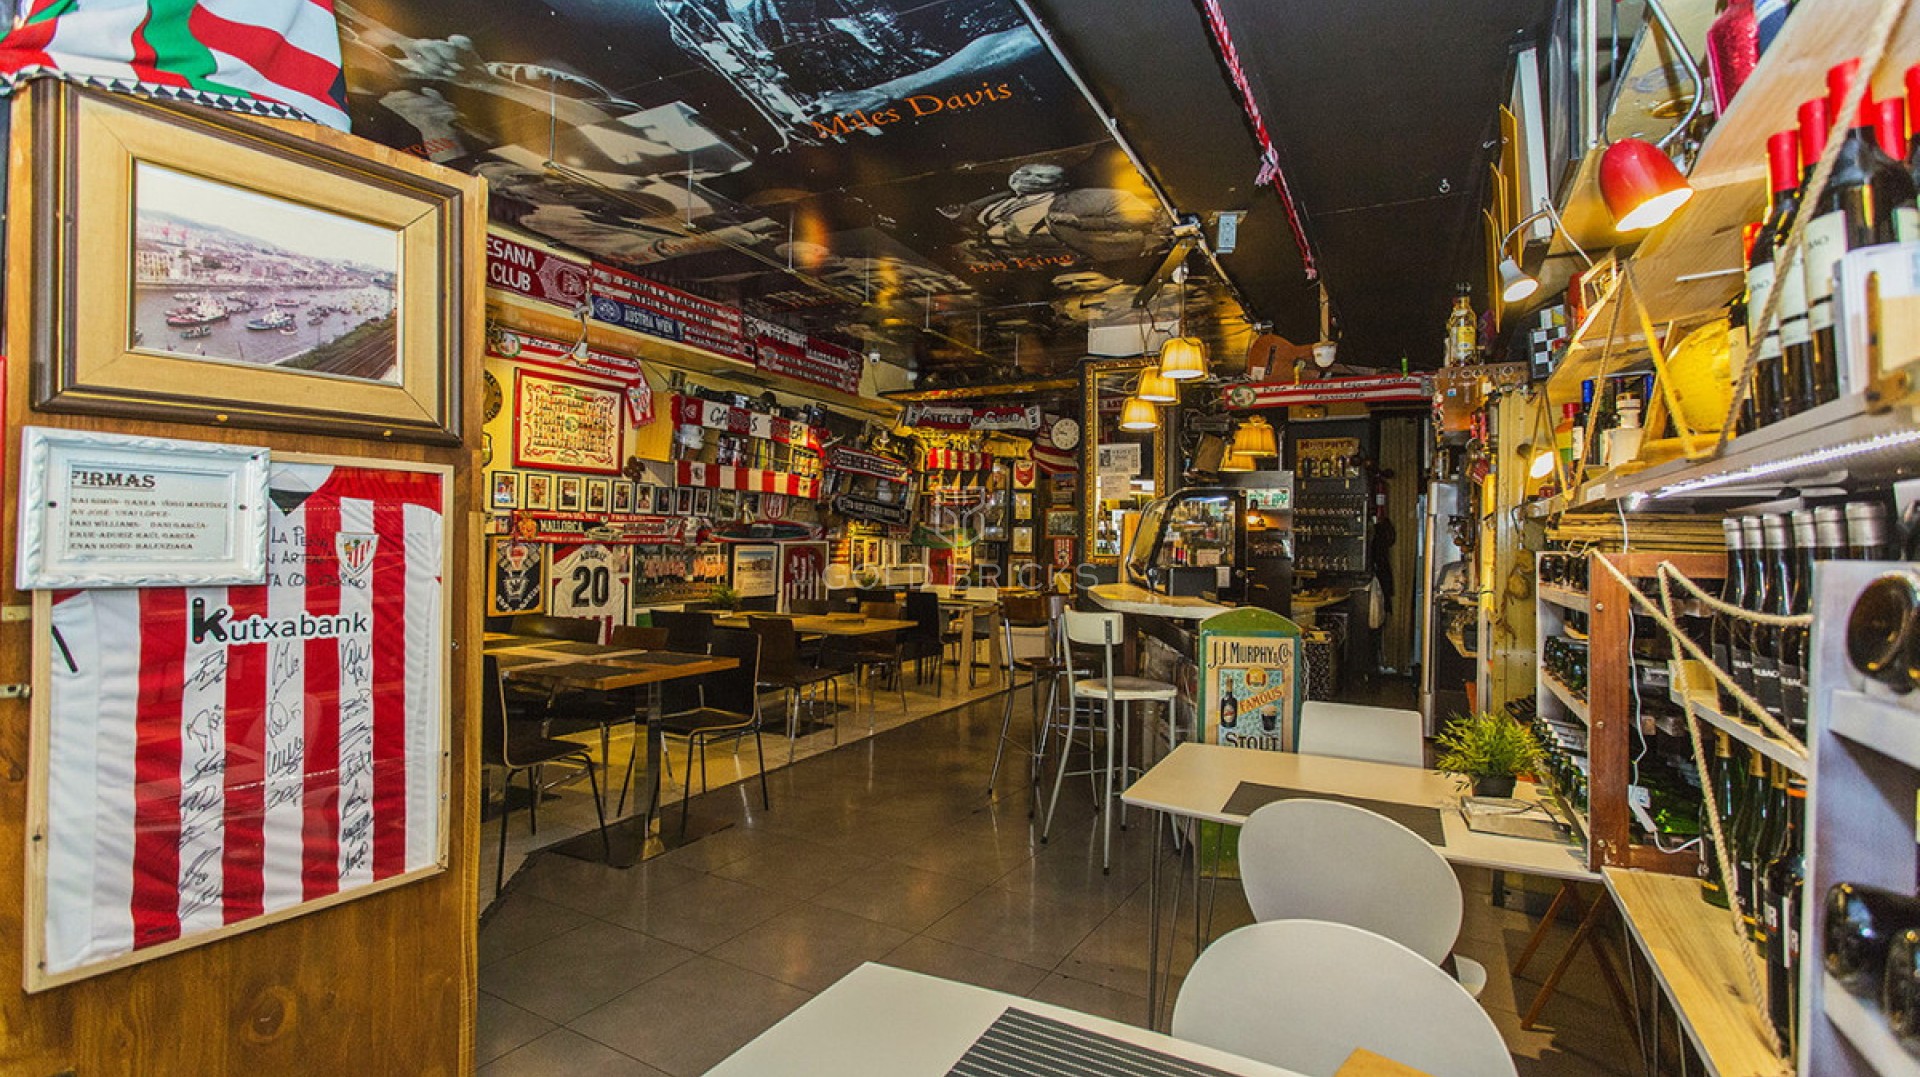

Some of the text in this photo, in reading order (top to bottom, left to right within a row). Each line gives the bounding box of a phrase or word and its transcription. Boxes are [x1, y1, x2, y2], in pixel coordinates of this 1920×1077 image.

[810, 81, 1013, 138] Miles Davis
[490, 262, 531, 291] CLUB
[72, 470, 156, 489] FIRMAS
[540, 519, 583, 533] MALLORCA
[571, 566, 609, 607] 20
[192, 597, 368, 645] Kutxabank
[1239, 687, 1283, 713] FAMOUS
[1225, 731, 1279, 752] STOUT
